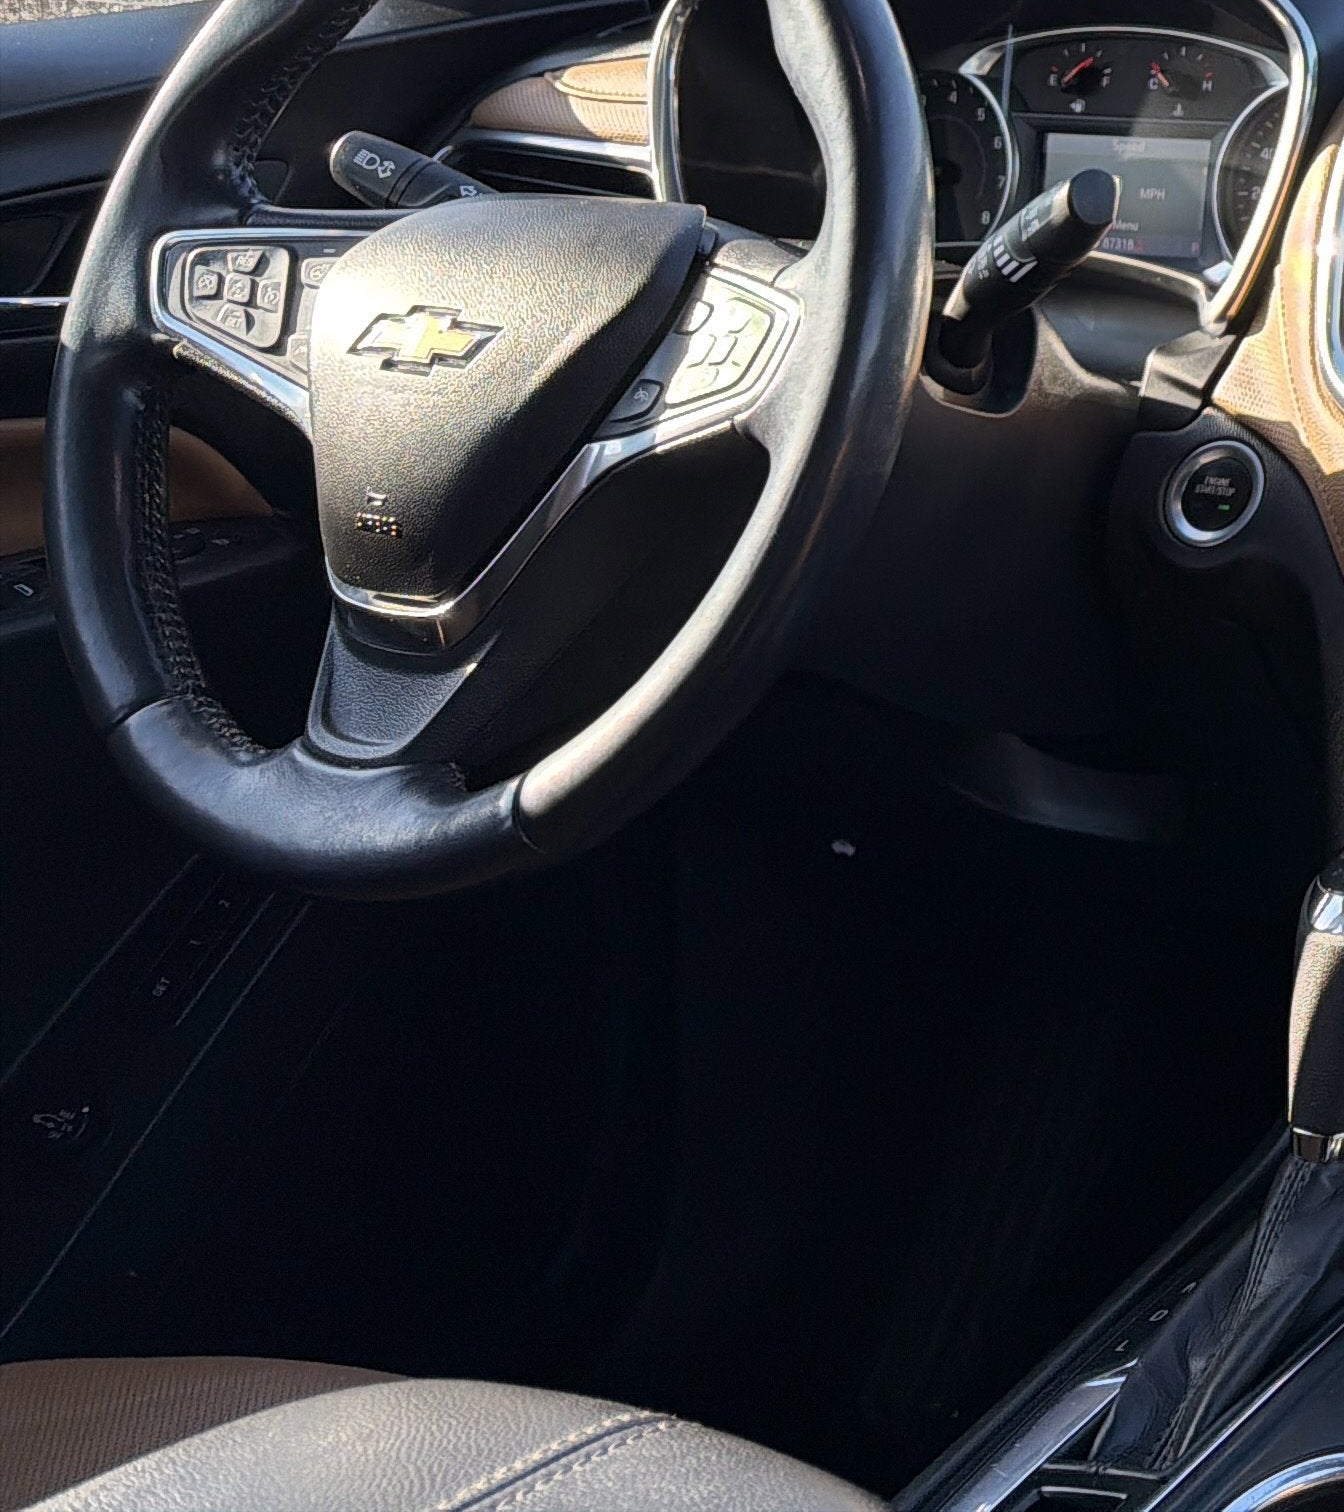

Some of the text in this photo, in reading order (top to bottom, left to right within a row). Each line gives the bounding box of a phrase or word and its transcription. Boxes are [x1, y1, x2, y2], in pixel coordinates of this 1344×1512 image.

[1202, 79, 1213, 92] H
[947, 90, 957, 105] 4
[977, 107, 986, 121] 5
[1139, 187, 1166, 201] MPH
